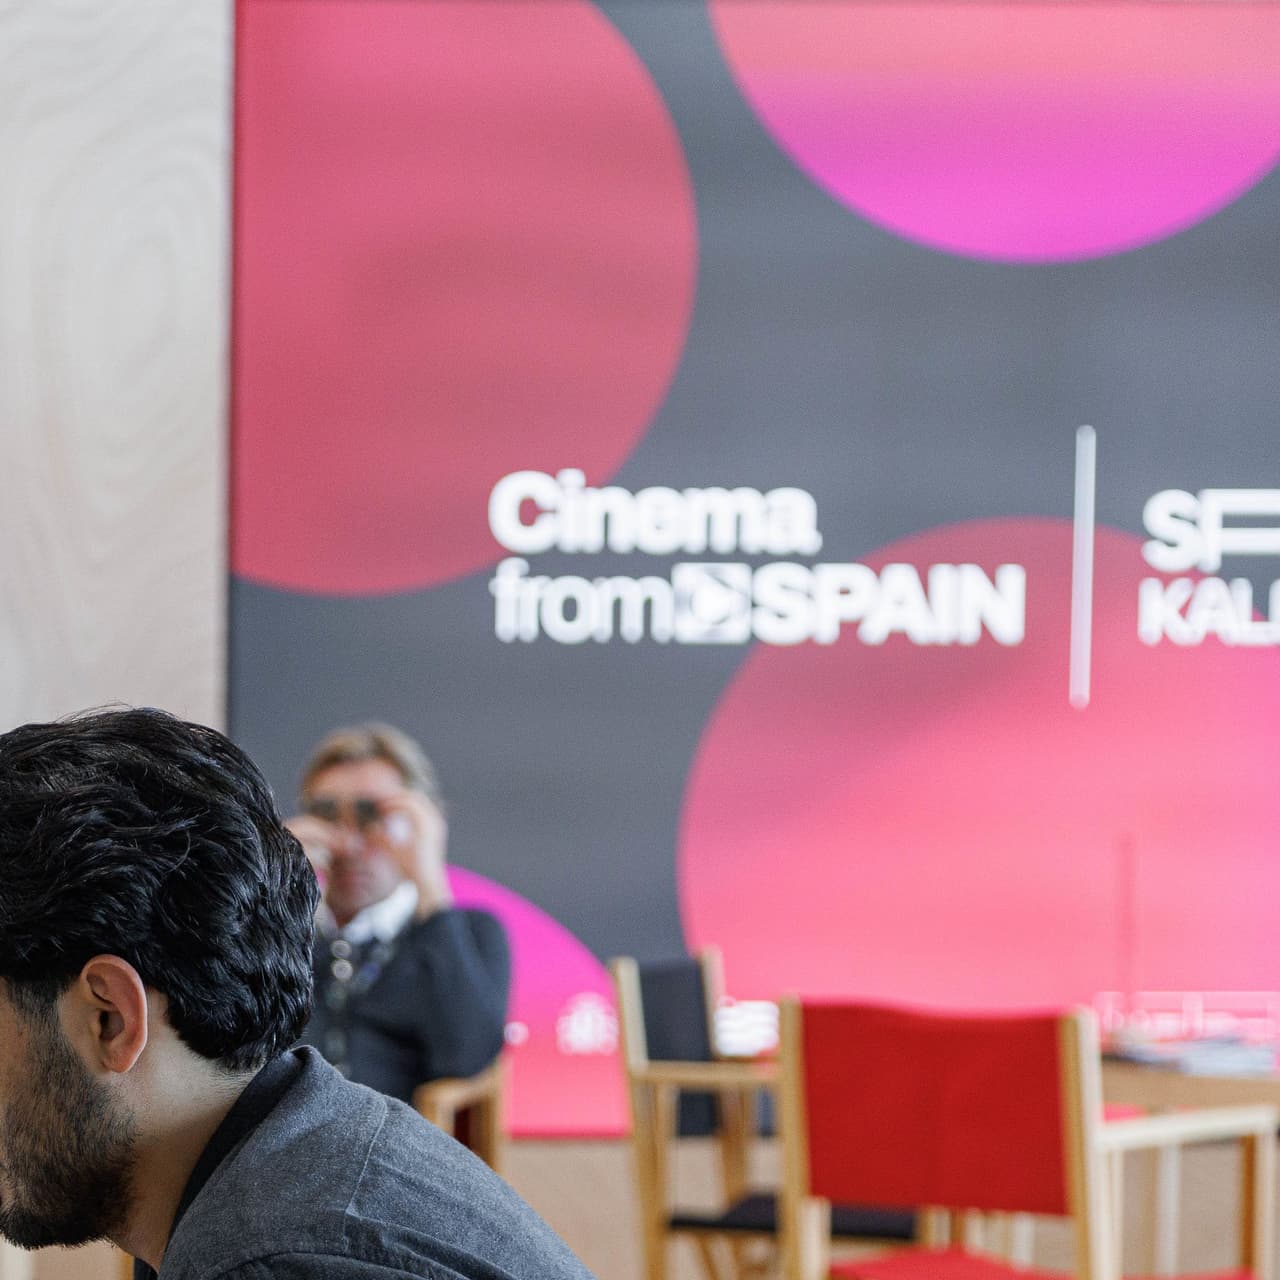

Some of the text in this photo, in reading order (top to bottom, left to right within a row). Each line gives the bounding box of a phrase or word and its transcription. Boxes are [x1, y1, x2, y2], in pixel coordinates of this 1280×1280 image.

[488, 468, 823, 555] Cinema
[489, 557, 1027, 646] from SPAIN
